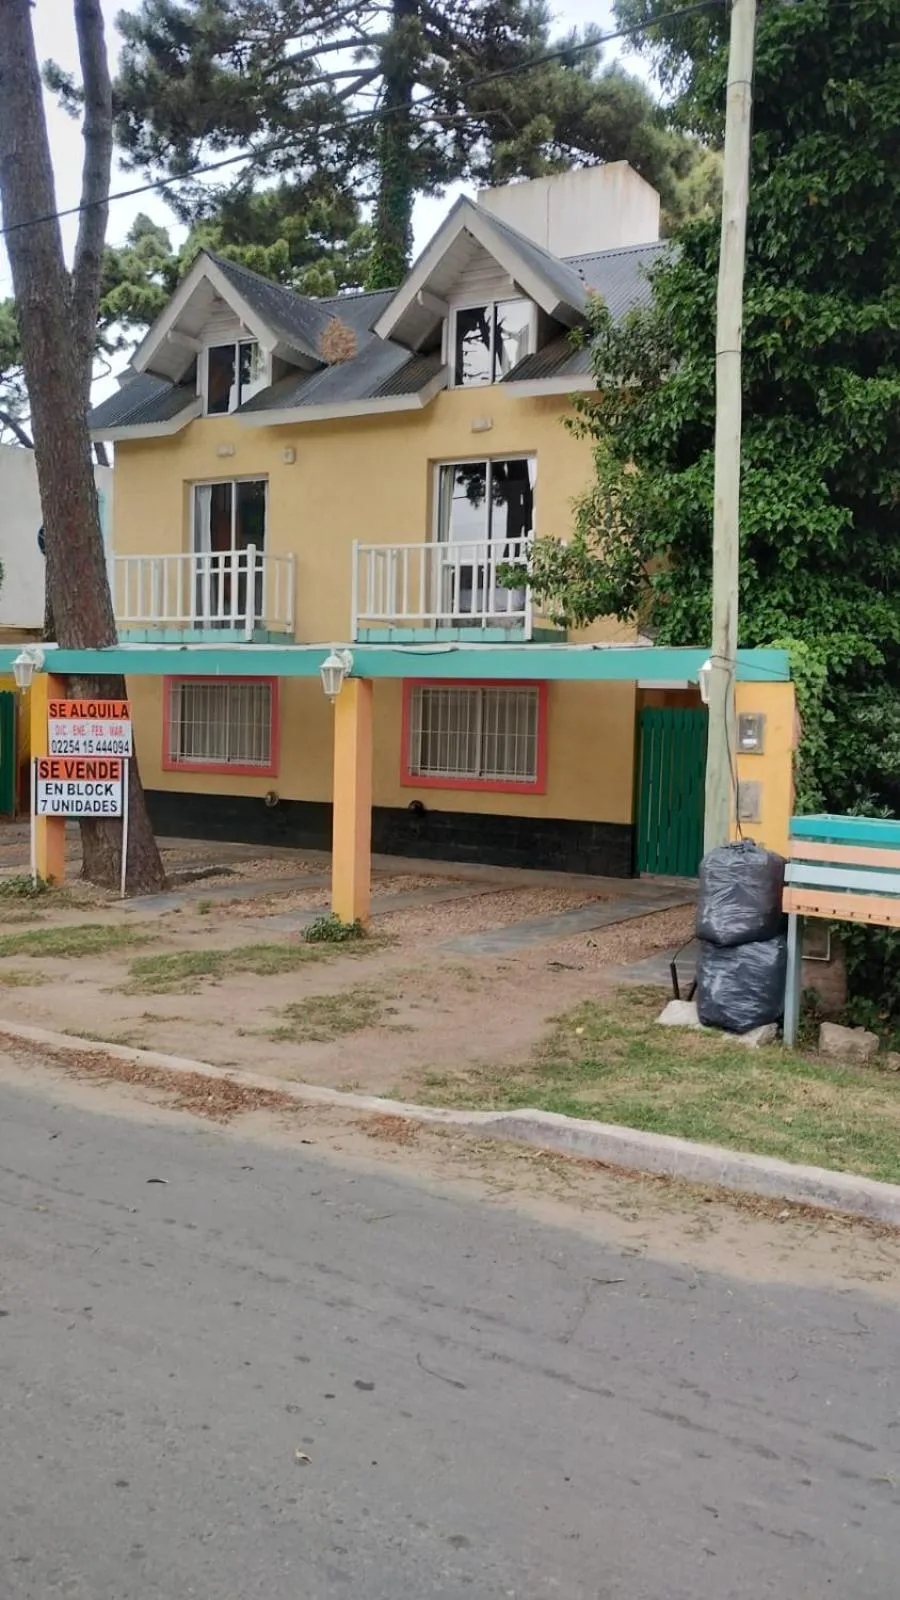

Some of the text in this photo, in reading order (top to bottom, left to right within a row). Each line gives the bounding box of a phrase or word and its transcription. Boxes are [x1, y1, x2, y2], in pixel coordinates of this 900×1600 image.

[49, 703, 129, 718] SE ALQUILA
[51, 740, 129, 754] 02254 15 444094
[40, 760, 119, 779] SE VENDE
[45, 783, 114, 796] EN BLOCK
[41, 800, 118, 813] 7 UNIDADES
